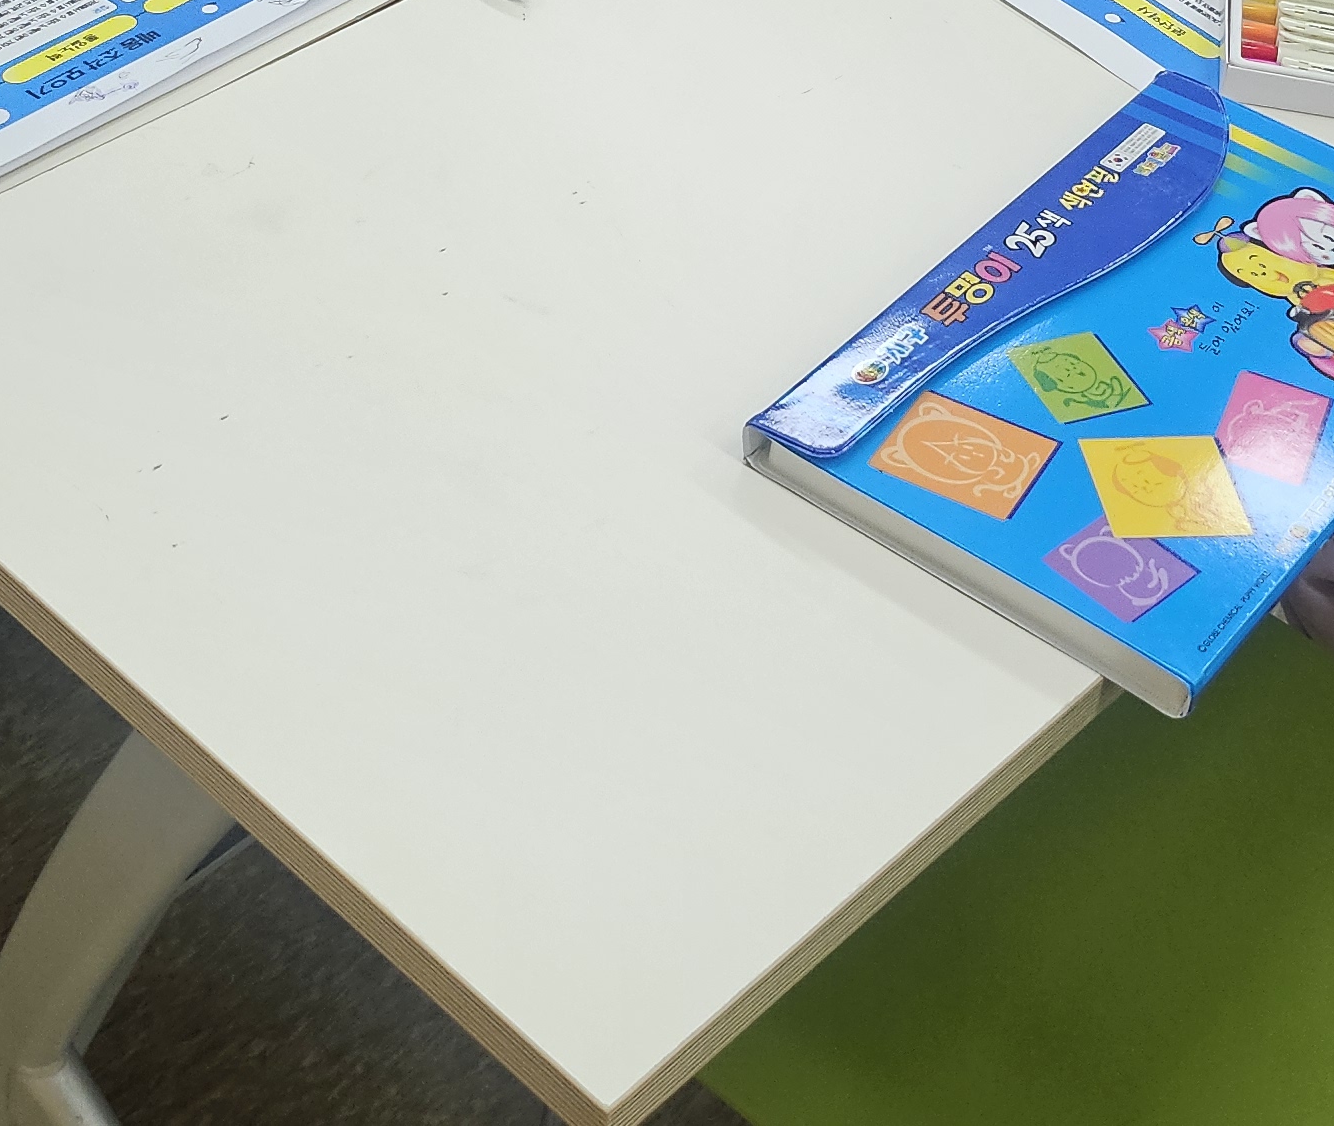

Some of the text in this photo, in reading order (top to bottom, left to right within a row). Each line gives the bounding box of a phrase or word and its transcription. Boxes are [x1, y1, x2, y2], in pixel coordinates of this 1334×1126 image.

[23, 26, 163, 101] 배움 조각 모으기
[1058, 166, 1120, 209] 색연필
[922, 250, 1023, 327] 투명이
[1004, 206, 1073, 259] 25색
[1198, 301, 1259, 355] 들어 있어요!
